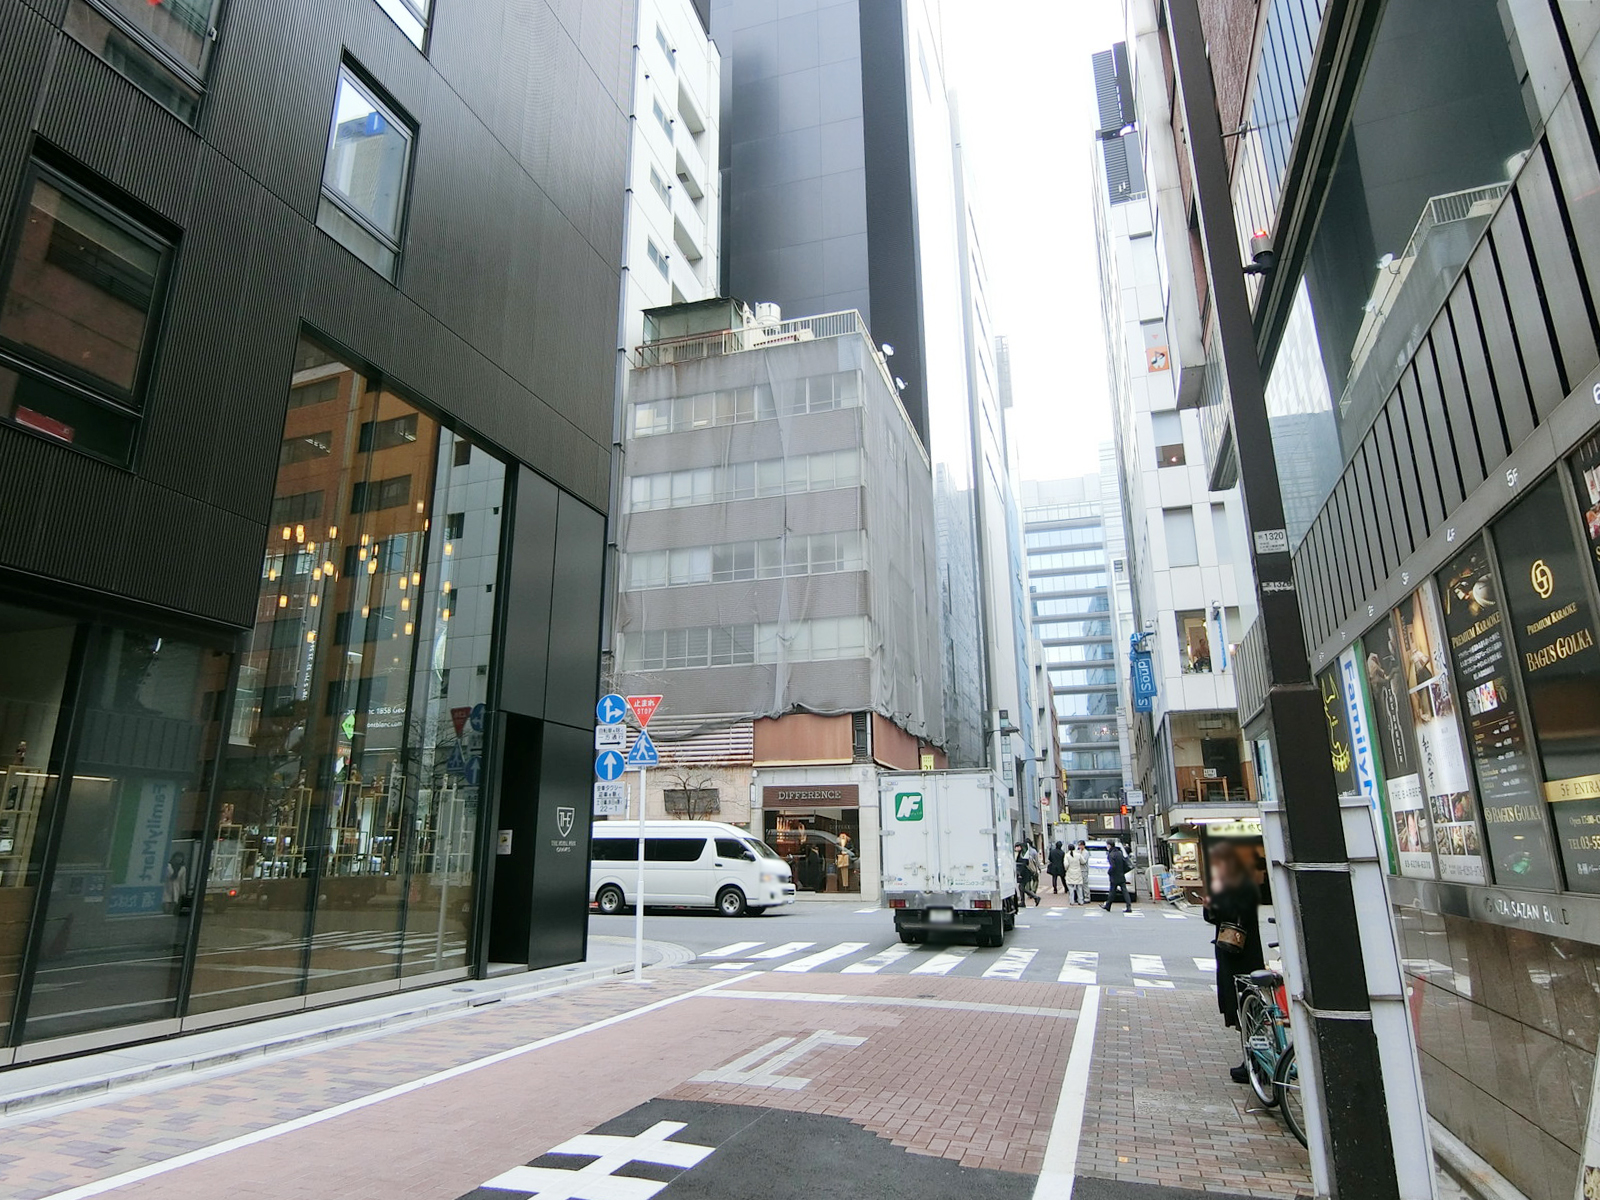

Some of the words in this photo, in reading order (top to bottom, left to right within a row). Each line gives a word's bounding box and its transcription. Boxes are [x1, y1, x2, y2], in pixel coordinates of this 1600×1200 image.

[1506, 467, 1519, 487] 5F
[1264, 531, 1284, 541] 1320
[1526, 616, 1552, 636] PREMIUM
[1550, 601, 1579, 625] KARAOKE
[1526, 643, 1558, 672] BAGUS
[1556, 628, 1594, 660] GOLKA
[1138, 661, 1152, 691] Soup
[634, 699, 655, 708] 止まれ
[778, 790, 842, 800] DIFFERENCE
[1575, 779, 1600, 796] ENTRA
[1511, 900, 1540, 920] SAZAN
